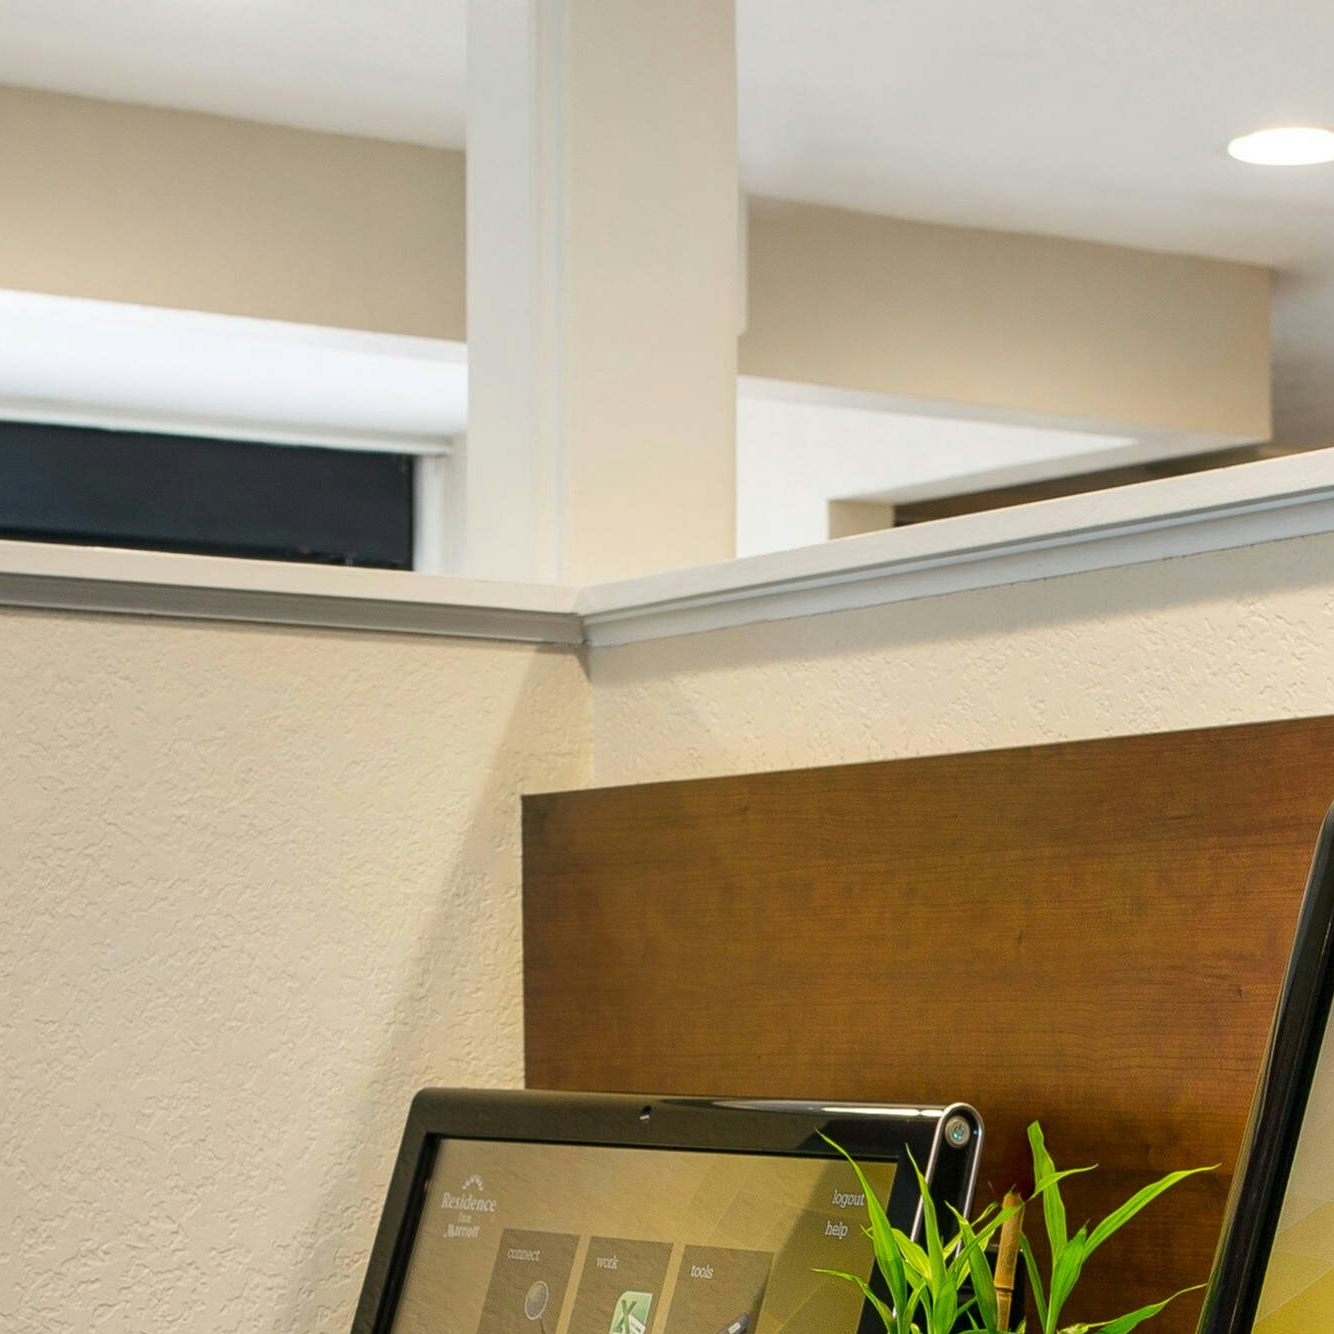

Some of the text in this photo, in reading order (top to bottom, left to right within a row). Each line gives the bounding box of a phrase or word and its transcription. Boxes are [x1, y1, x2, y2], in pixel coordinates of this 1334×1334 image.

[441, 1192, 497, 1212] Residence
[832, 1189, 865, 1208] logout
[825, 1220, 849, 1240] help
[690, 1264, 715, 1280] tools
